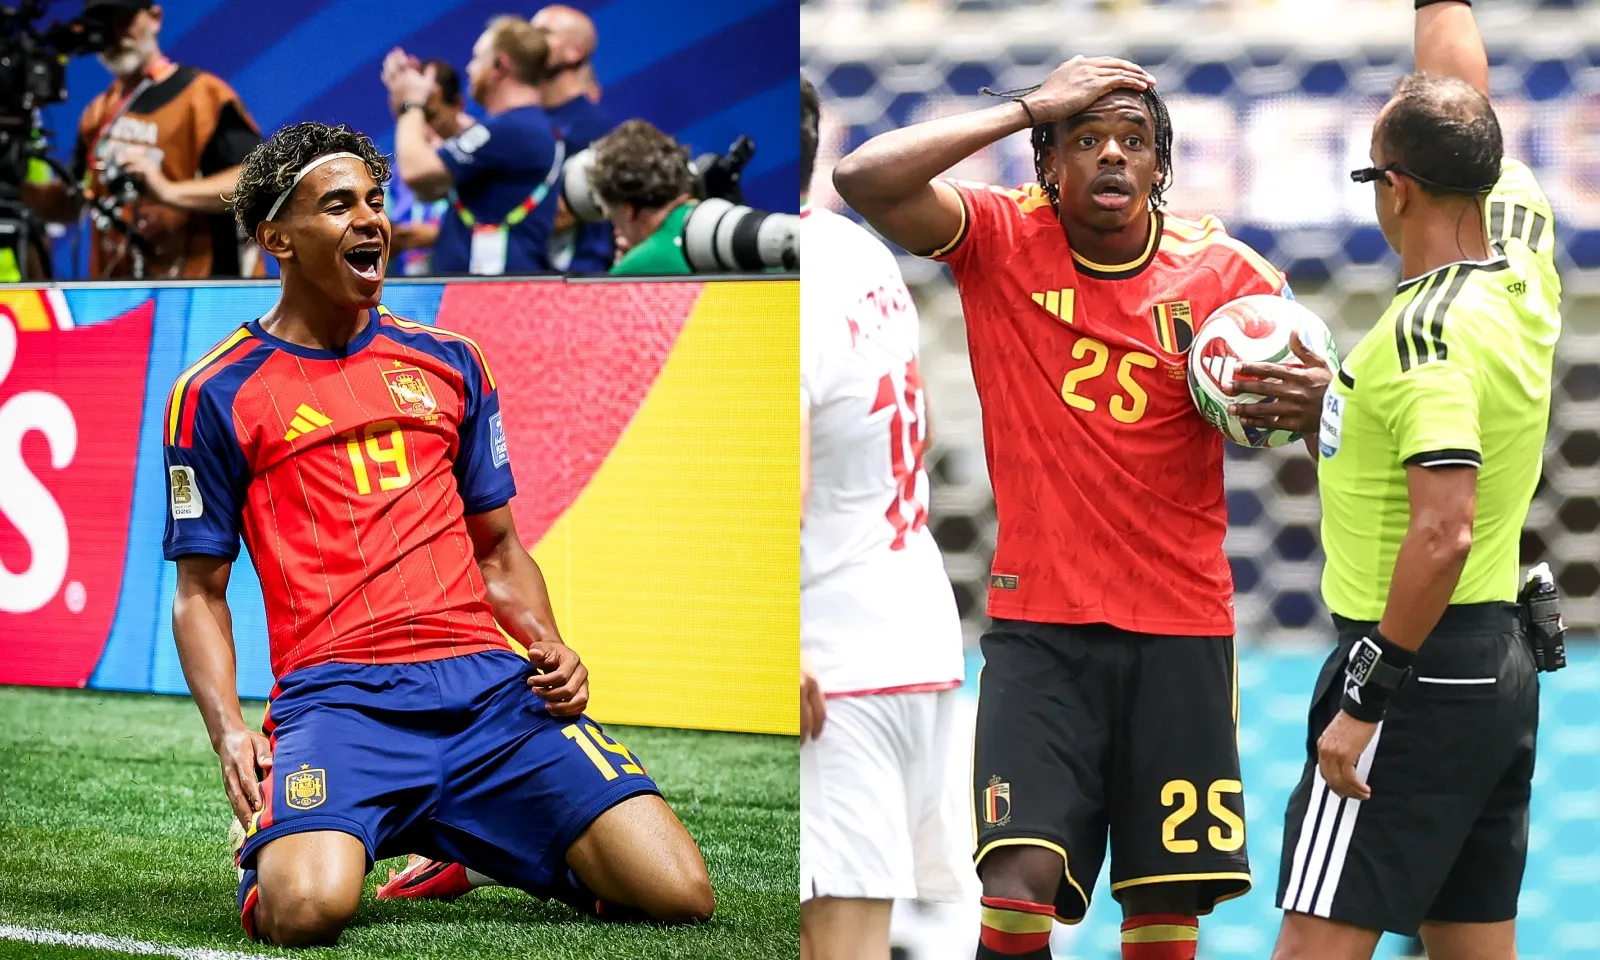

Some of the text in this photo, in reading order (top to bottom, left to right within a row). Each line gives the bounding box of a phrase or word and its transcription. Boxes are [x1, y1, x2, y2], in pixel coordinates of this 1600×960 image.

[1061, 338, 1157, 424] 25
[340, 419, 412, 495] 19
[1352, 646, 1375, 681] 52:16
[560, 723, 645, 782] 19
[1160, 779, 1245, 854] 25
